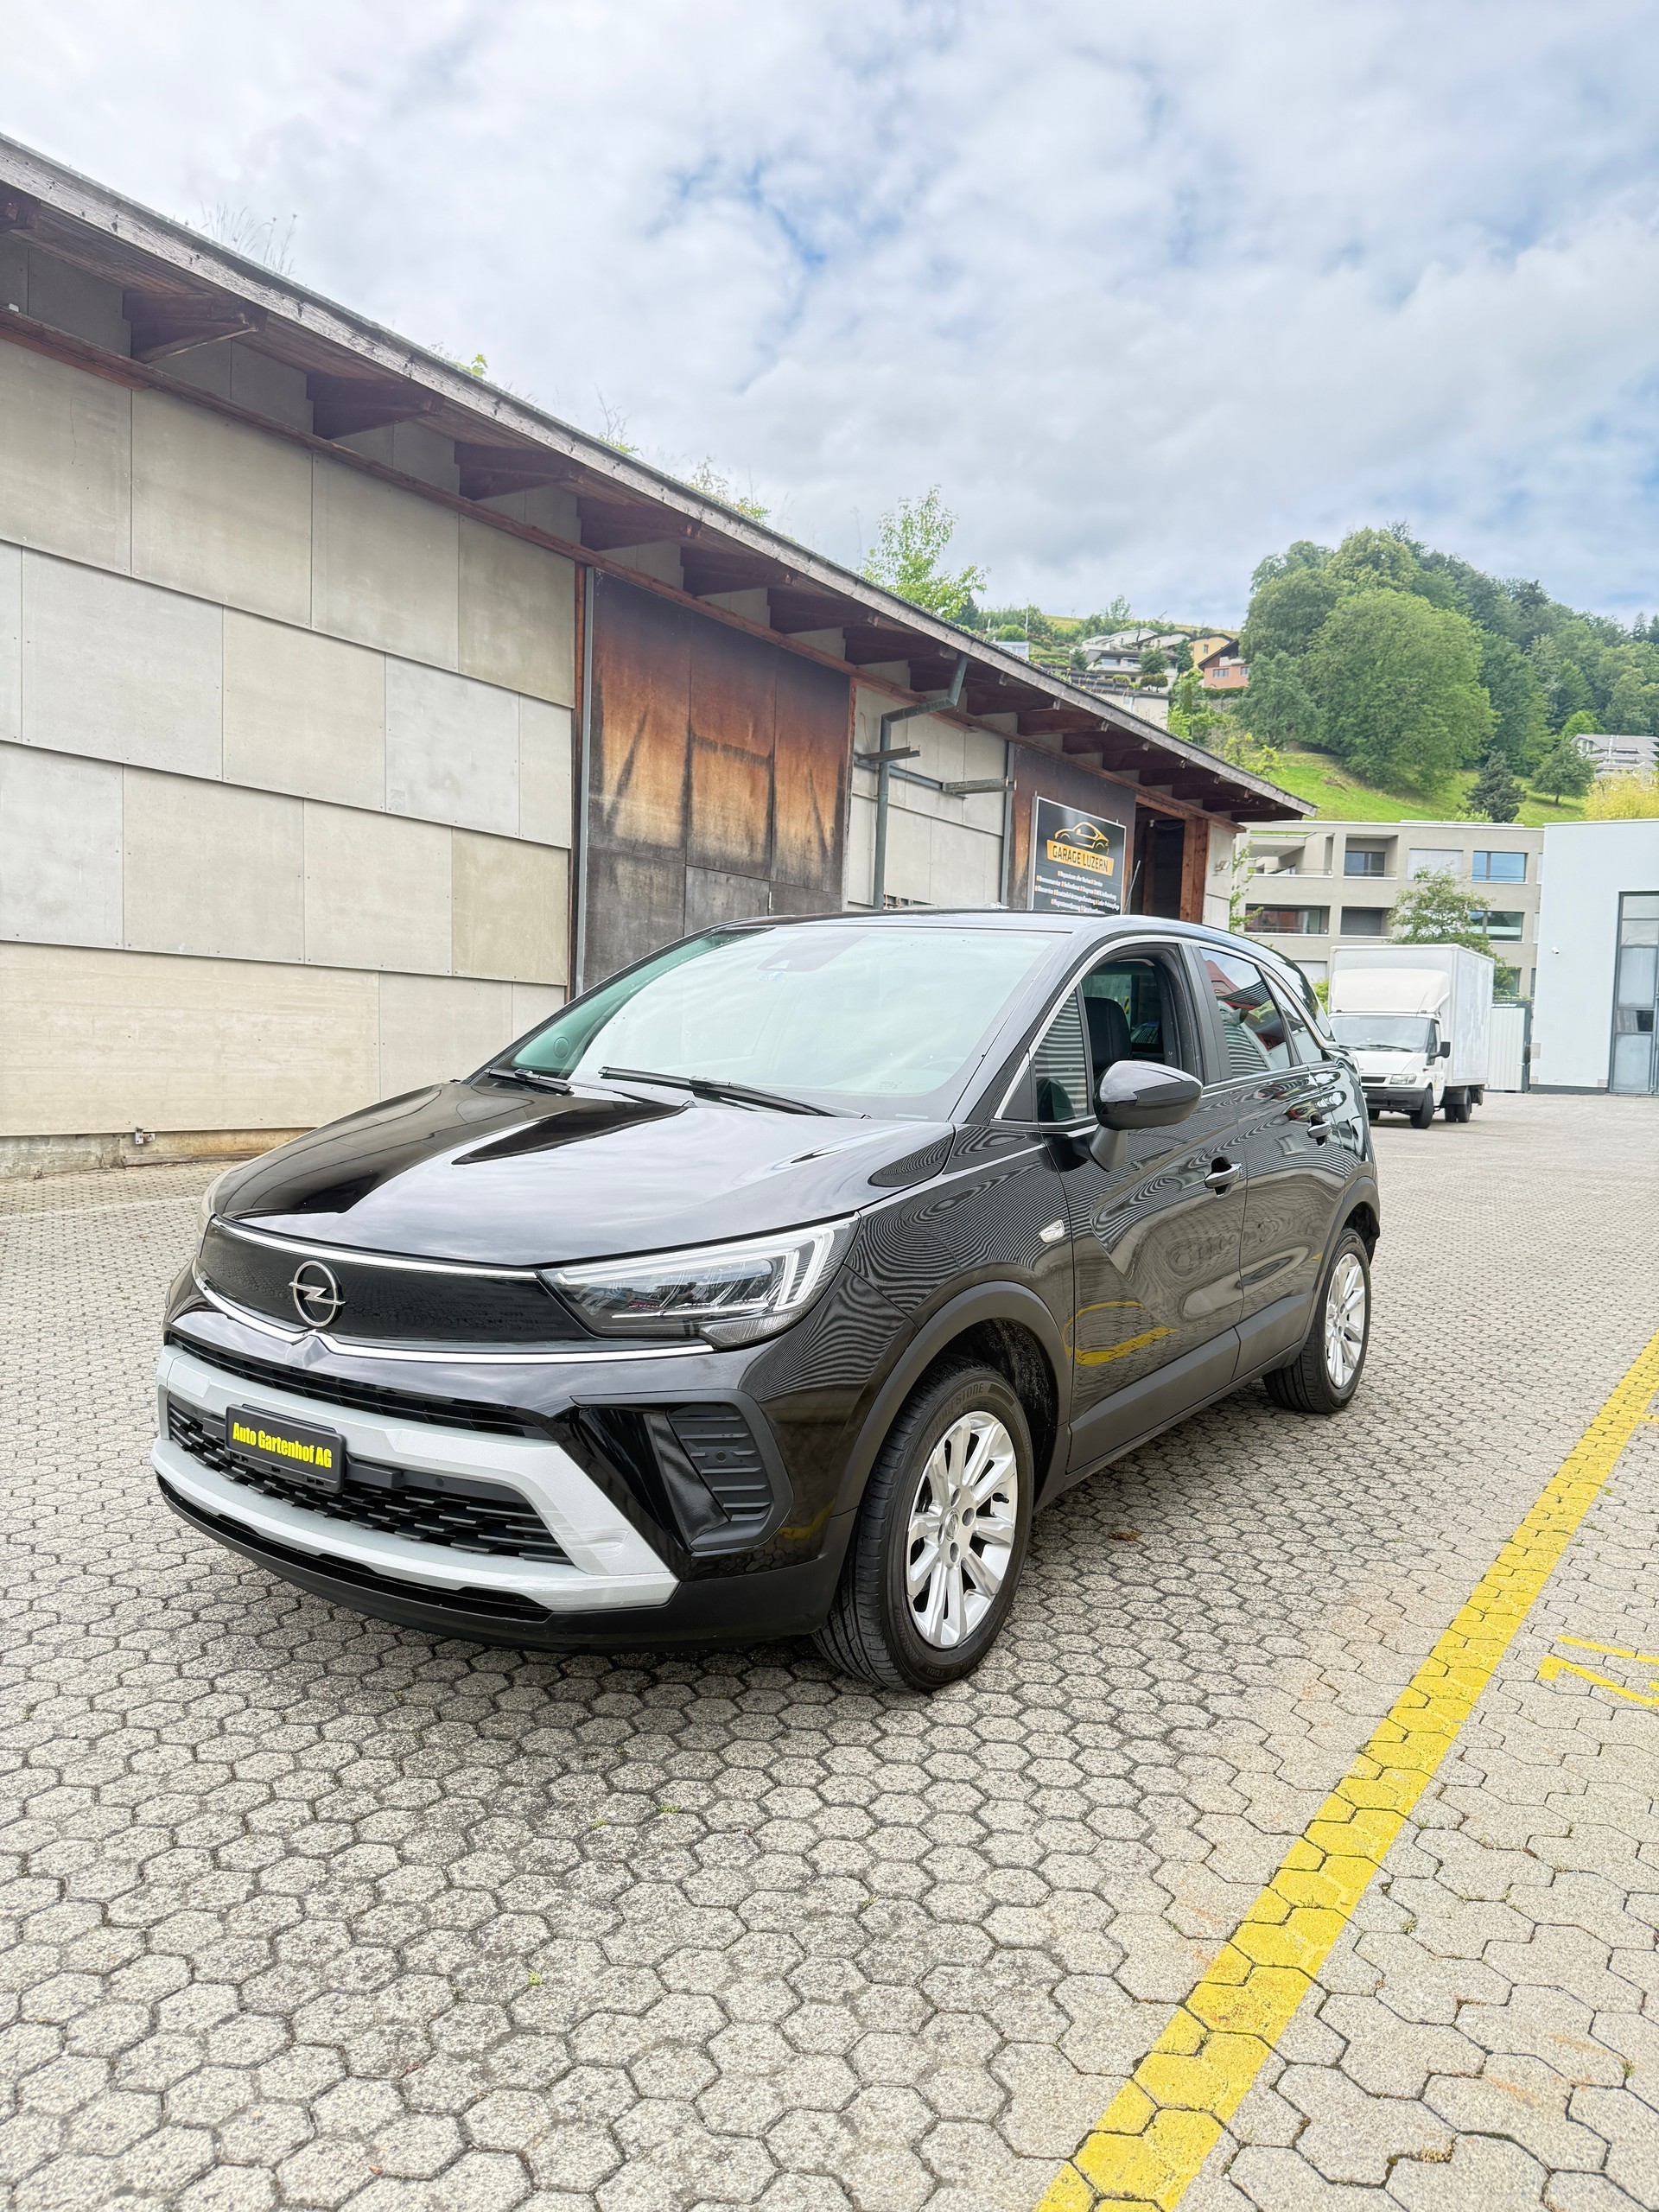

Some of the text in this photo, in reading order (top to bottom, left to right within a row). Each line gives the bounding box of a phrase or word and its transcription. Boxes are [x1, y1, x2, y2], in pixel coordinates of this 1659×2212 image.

[1053, 846, 1109, 872] GARAGE LUZERN
[232, 1422, 333, 1468] Auto Gartenhof AG
